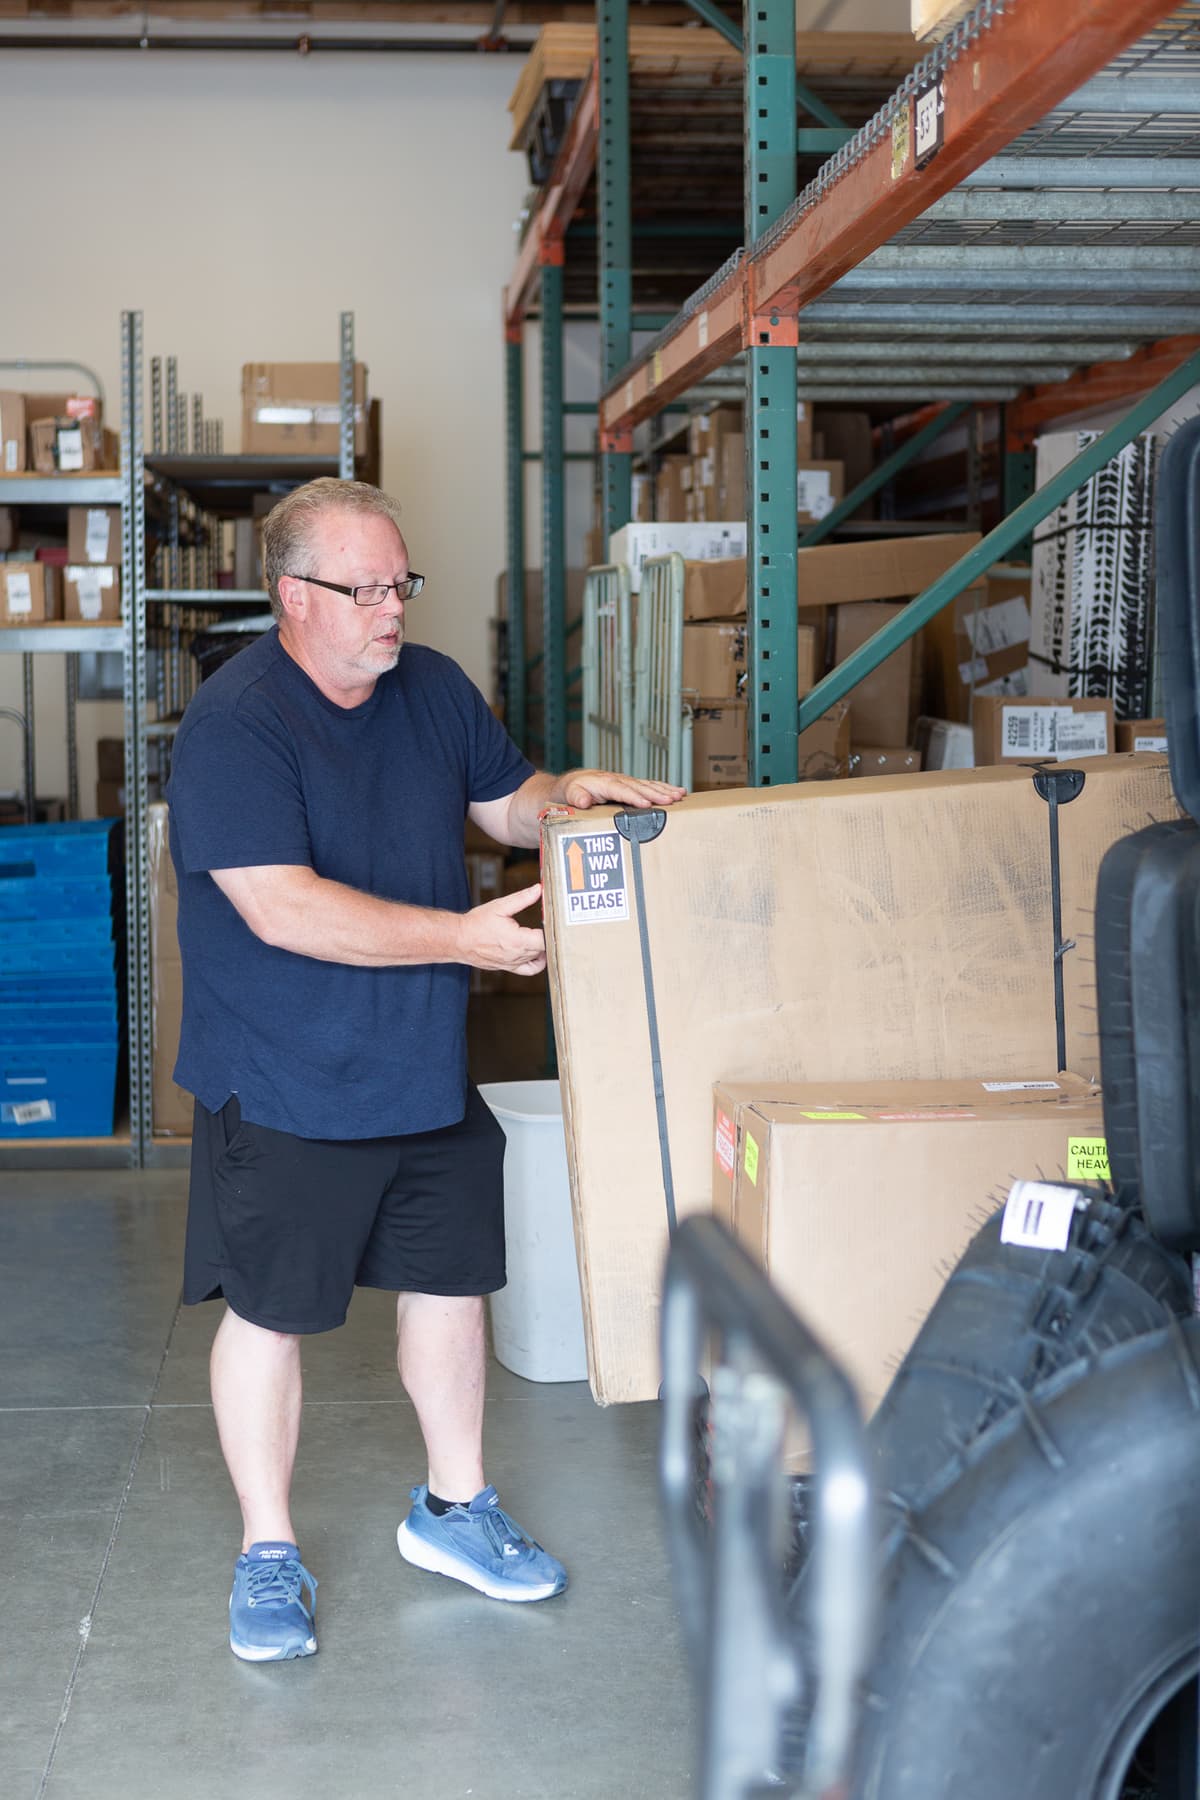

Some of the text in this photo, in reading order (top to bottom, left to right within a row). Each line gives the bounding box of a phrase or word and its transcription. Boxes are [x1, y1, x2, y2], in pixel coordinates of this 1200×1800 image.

[584, 836, 615, 853] THIS
[588, 854, 619, 871] WAY
[590, 873, 609, 889] UP
[570, 891, 624, 911] PLEASE
[1070, 1145, 1106, 1156] CAUTI
[1077, 1159, 1109, 1169] HEAV
